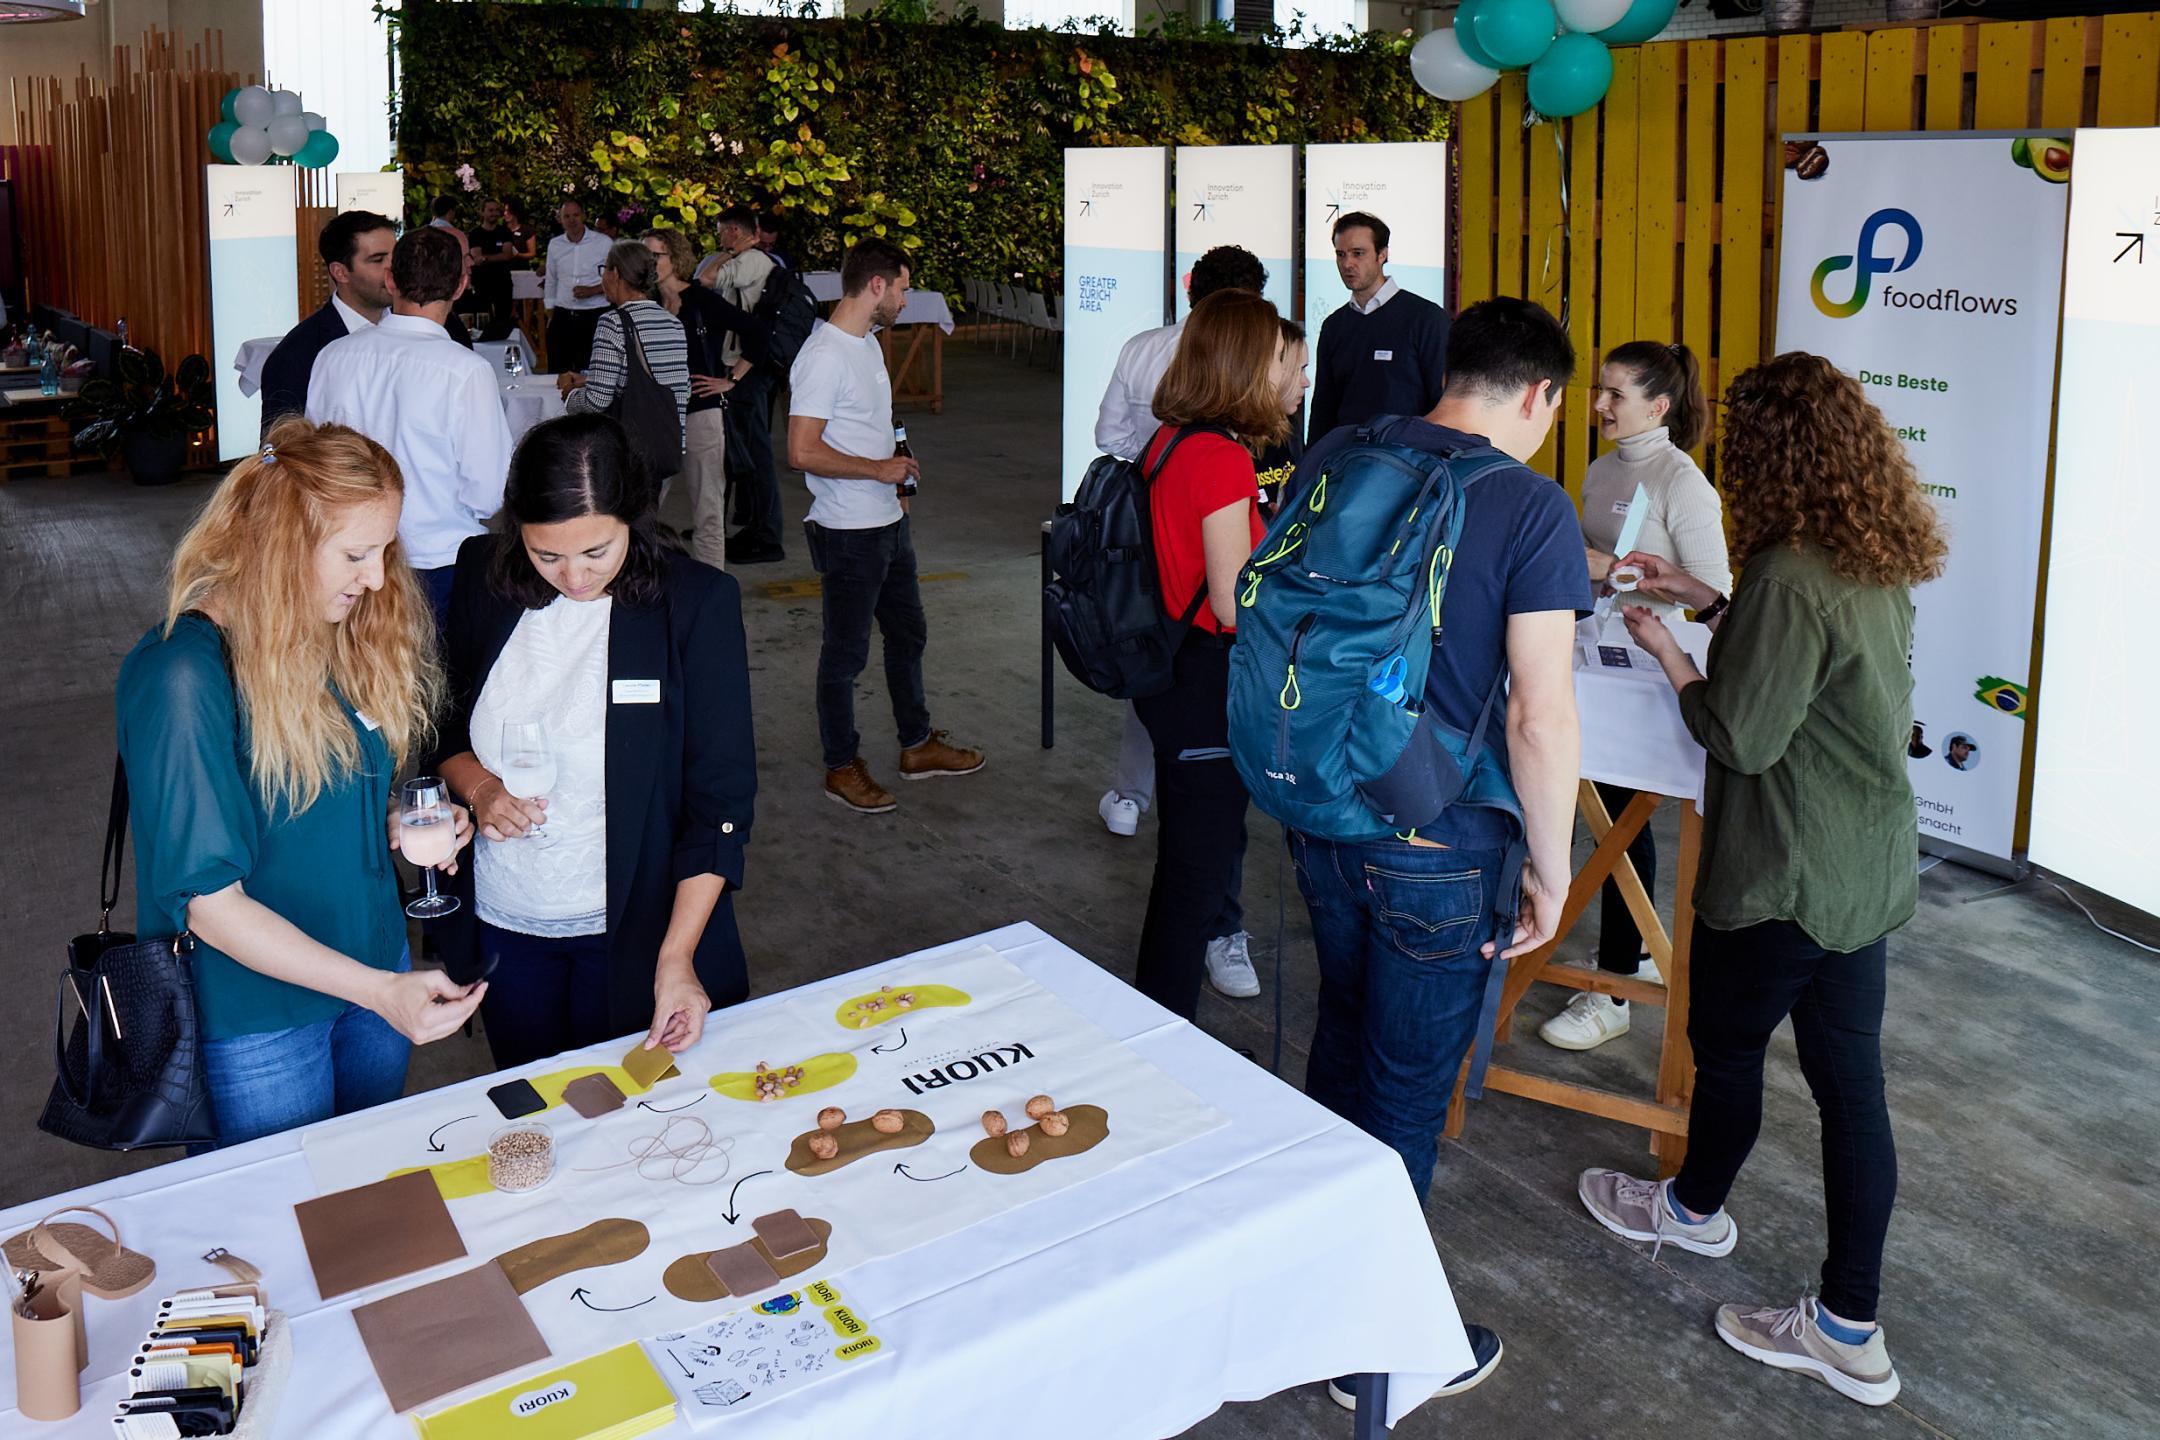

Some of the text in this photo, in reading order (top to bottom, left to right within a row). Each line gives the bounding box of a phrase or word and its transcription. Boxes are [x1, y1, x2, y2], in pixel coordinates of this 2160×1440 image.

[1207, 184, 1244, 192] Innovation
[1342, 180, 1388, 191] Innovation
[1207, 192, 1229, 200] Zurich
[1342, 191, 1369, 201] Zurich
[1079, 275, 1117, 290] GREATER
[1079, 287, 1111, 302] ZURICH
[1883, 285, 2018, 316] foodflows
[1079, 300, 1103, 312] AREA
[1859, 370, 1949, 392] Das Beste
[1896, 426, 1927, 442] ekt
[1919, 482, 1957, 499] arm
[1918, 815, 1962, 835] snacht
[901, 1042, 1035, 1095] KUORI
[811, 1281, 835, 1303] UORI
[834, 1308, 862, 1334] KUORI
[841, 1338, 874, 1355] KUORI
[519, 1388, 569, 1412] KUORI
